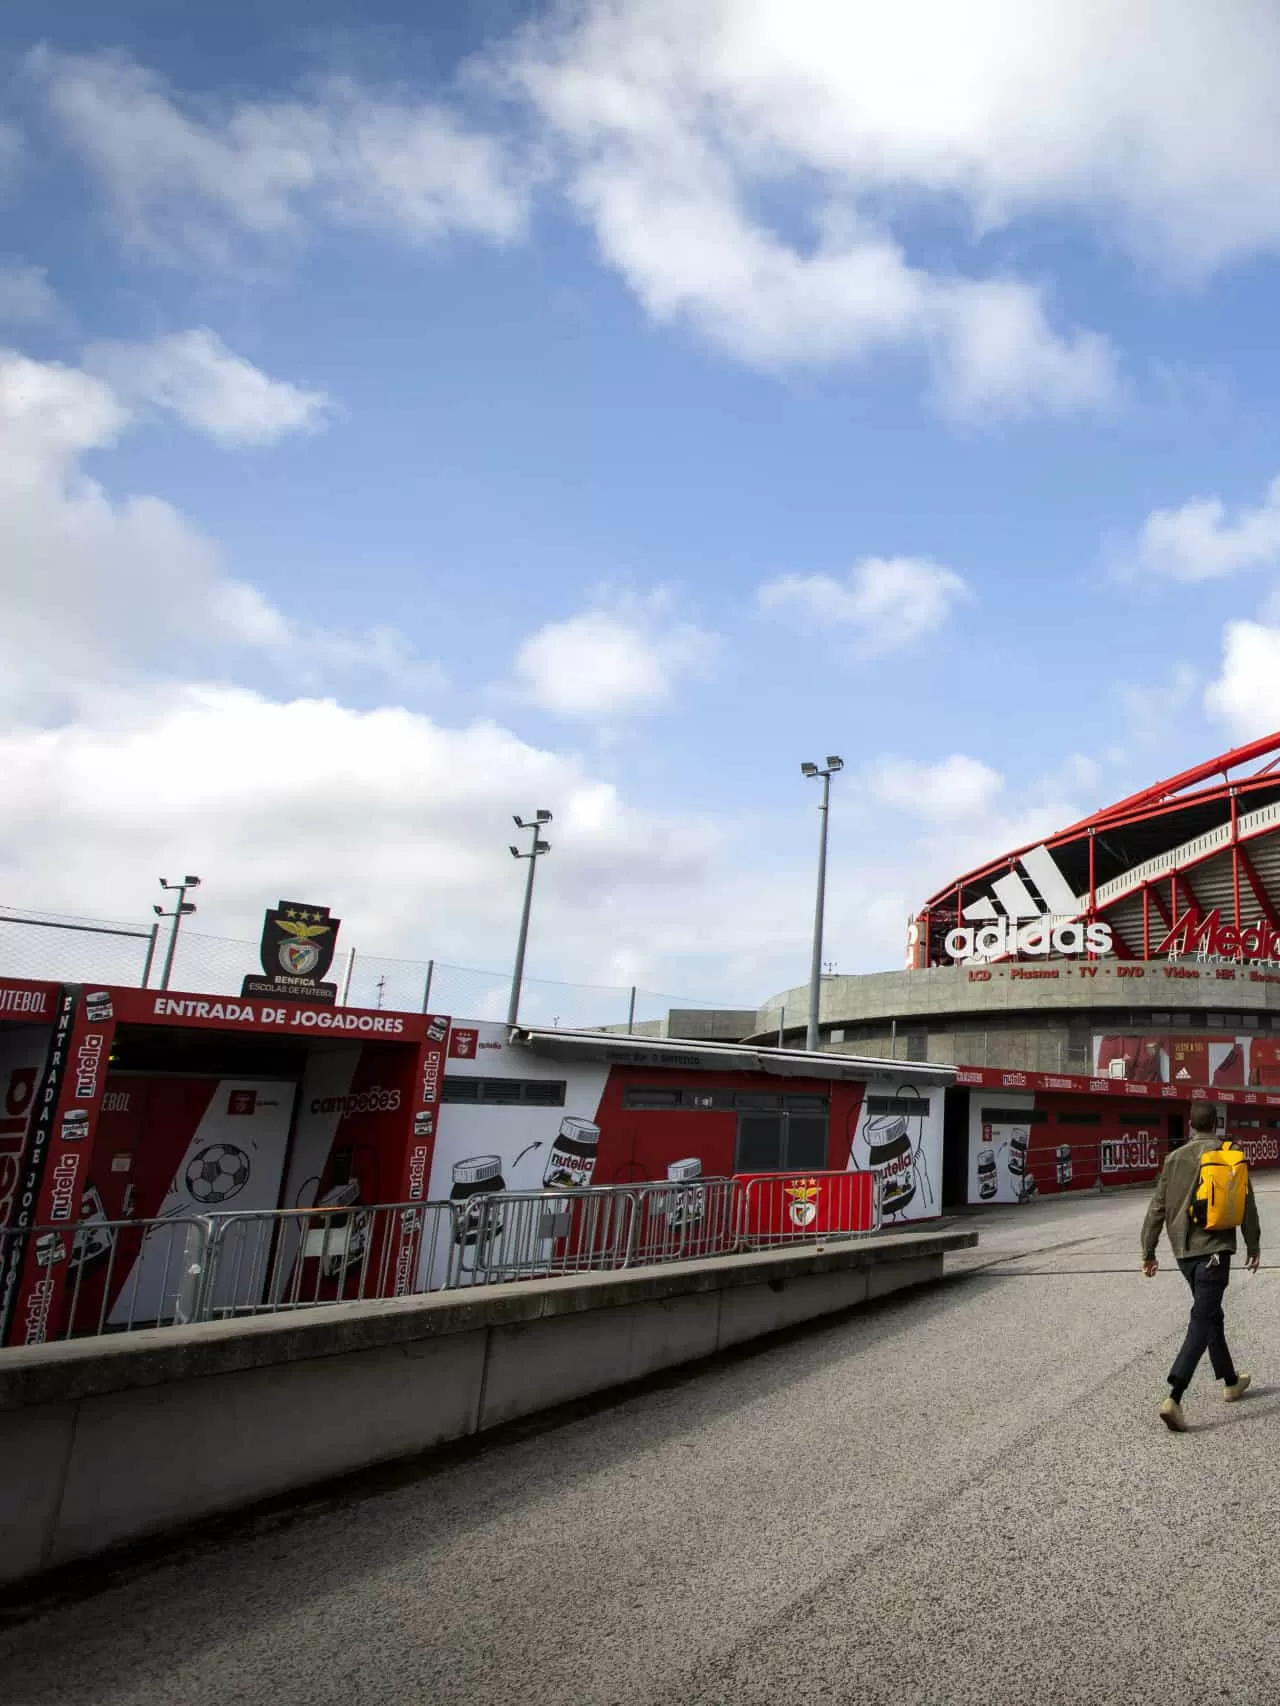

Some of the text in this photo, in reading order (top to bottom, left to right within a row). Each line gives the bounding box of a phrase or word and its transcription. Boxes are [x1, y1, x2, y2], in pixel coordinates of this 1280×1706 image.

[945, 915, 1113, 958] adidas
[249, 983, 287, 993] ESCOLAS
[288, 986, 299, 994] DE
[275, 976, 316, 987] BENFICA
[968, 970, 992, 982] LCD
[1010, 968, 1060, 980] Plasma
[1080, 967, 1098, 978] TV
[1117, 966, 1145, 978] DVD
[1164, 967, 1200, 979] Video
[154, 998, 404, 1033] ENTRADA DE JOGADORES
[40, 996, 72, 1121] ENTRADA
[76, 1034, 103, 1098] nutella
[423, 1051, 440, 1103] nutella
[310, 1085, 401, 1119] campeões
[410, 1146, 427, 1200] nutella
[551, 1153, 594, 1172] nutella
[1101, 1130, 1160, 1173] nutella
[51, 1154, 80, 1221] nutella
